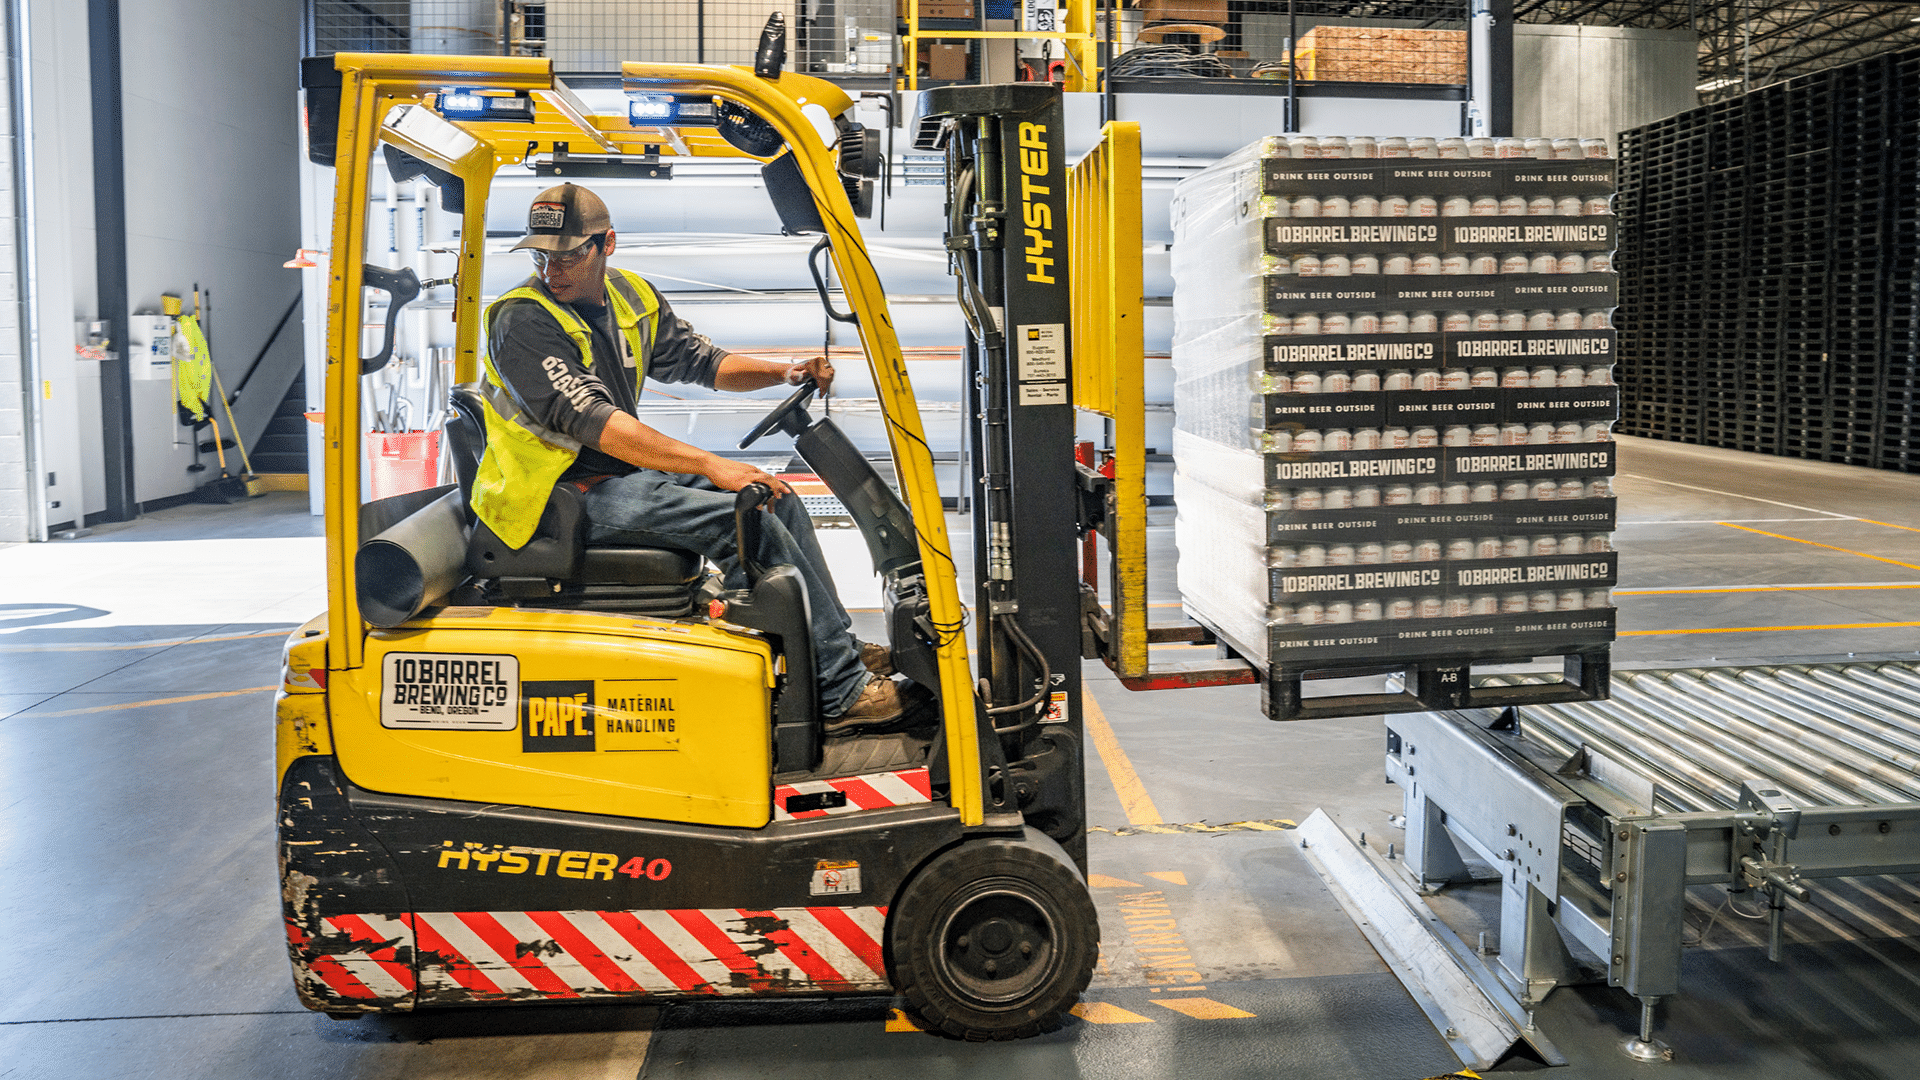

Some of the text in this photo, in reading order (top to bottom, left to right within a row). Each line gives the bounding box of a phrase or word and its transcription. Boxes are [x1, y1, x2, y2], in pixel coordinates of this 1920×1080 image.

[1333, 172, 1373, 180] OUTSIDE
[1394, 170, 1492, 178] DRINK BEER OUTSIDE
[1514, 174, 1609, 182] DRINK BEER OUTSIDE
[1018, 121, 1056, 285] HYSTER
[1275, 291, 1376, 300] DRINK BEER OUTSIDE
[1398, 290, 1495, 299] DRINK BEER OUTSIDE
[1514, 285, 1609, 294] DRINK BEER OUTSIDE
[1275, 404, 1375, 414] DRINK BEER OUTSIDE
[1398, 402, 1496, 412] DRINK BEER OUTSIDE
[1516, 399, 1611, 410] DRINK BEER OUTSIDE
[1397, 513, 1493, 525] DRINK BEER OUTSIDE
[1516, 512, 1609, 524] DRINK BEER OUTSIDE
[1277, 520, 1377, 532] DRINK BEER OUTSIDE
[1514, 620, 1608, 633] DRINK BEER OUTSIDE
[1398, 627, 1494, 639] DRINK BEER OUTSIDE
[1279, 636, 1378, 649] DRINK BEER OUTSIDE
[606, 697, 676, 712] MATERIAL
[606, 718, 676, 733] HANDLING
[1115, 890, 1208, 993] WARNING!
